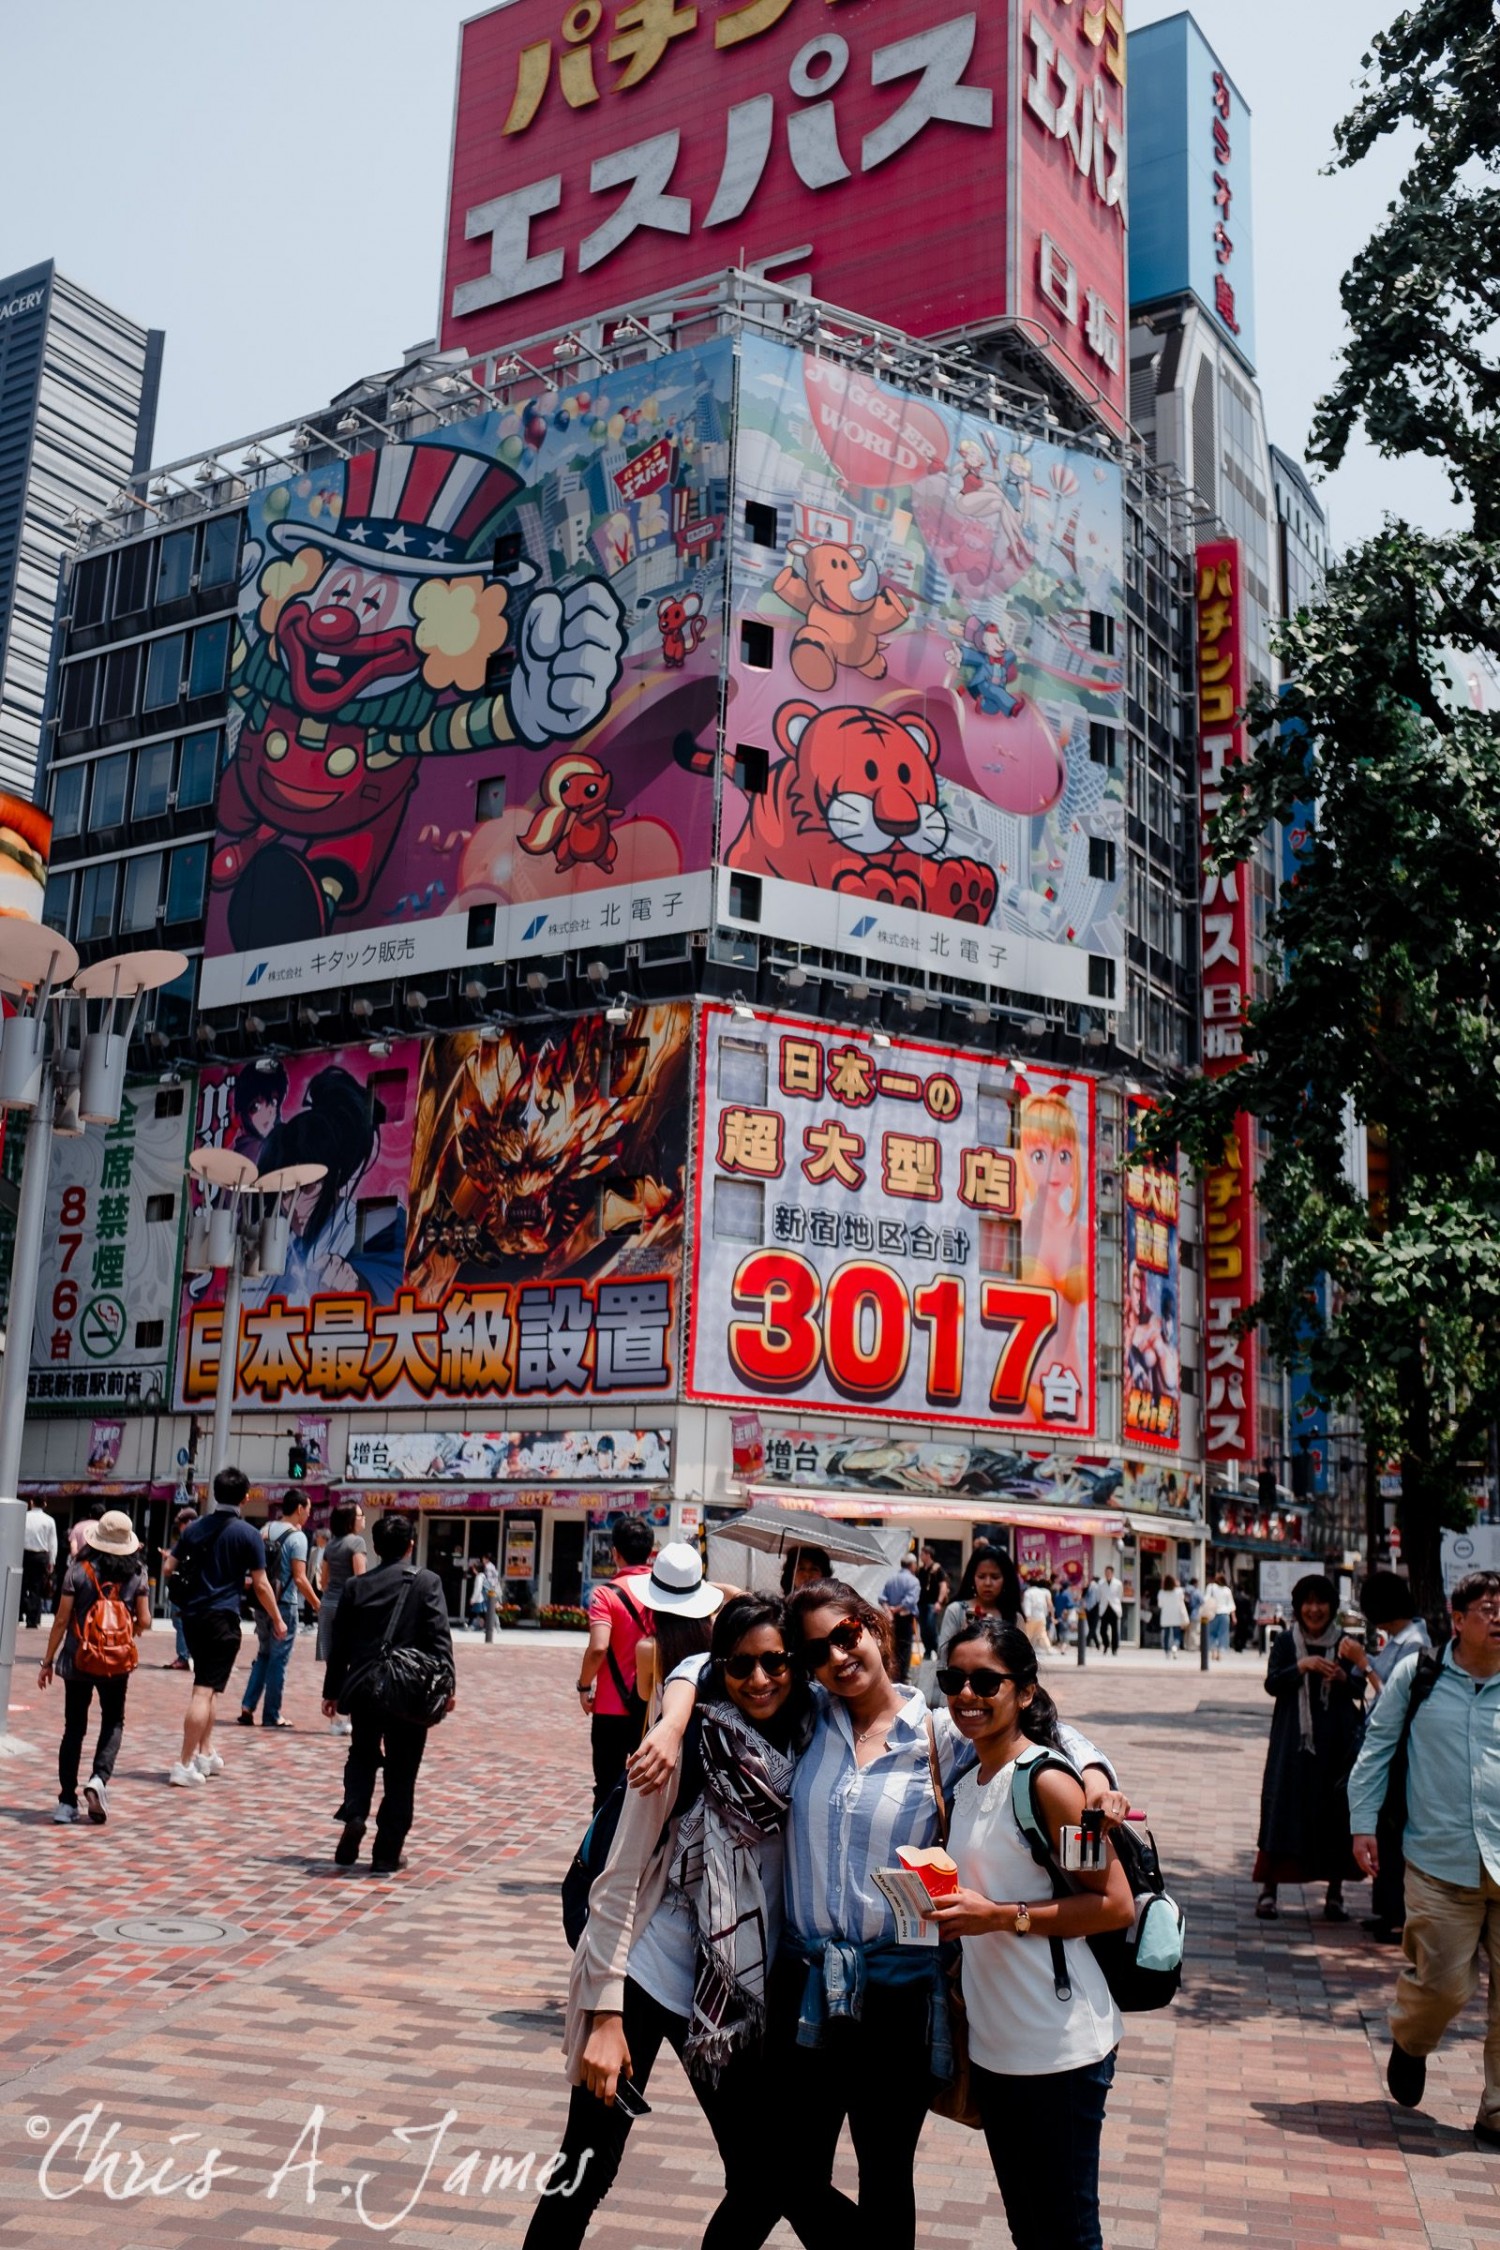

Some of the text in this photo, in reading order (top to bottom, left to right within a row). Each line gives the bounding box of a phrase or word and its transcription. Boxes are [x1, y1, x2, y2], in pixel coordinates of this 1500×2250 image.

[452, 12, 993, 317] エスパス
[1028, 11, 1128, 230] エスパス
[1212, 71, 1241, 335] カラオケ館
[1040, 229, 1119, 376] 日拓
[804, 363, 937, 464] JUGGLER
[819, 403, 918, 471] WORLD
[621, 456, 669, 500] エスパス
[1199, 559, 1234, 723] パチンコ
[267, 936, 416, 981] 株式会社 キタック販売
[548, 891, 684, 937] 株式会社 北電子
[877, 929, 1008, 970] 株式会社 北電子
[1202, 983, 1243, 1059] 日拓
[779, 1035, 963, 1122] 日本一の
[91, 1094, 139, 1291] 全席禁煙
[716, 1106, 1018, 1215] 超大型店
[51, 1185, 87, 1361] 876台
[773, 1201, 971, 1265] 新宿地区合計
[182, 1274, 676, 1403] 日本最大級設置
[1207, 1297, 1247, 1451] エスパス
[354, 1441, 389, 1465] 増台
[765, 1439, 819, 1472] 増台
